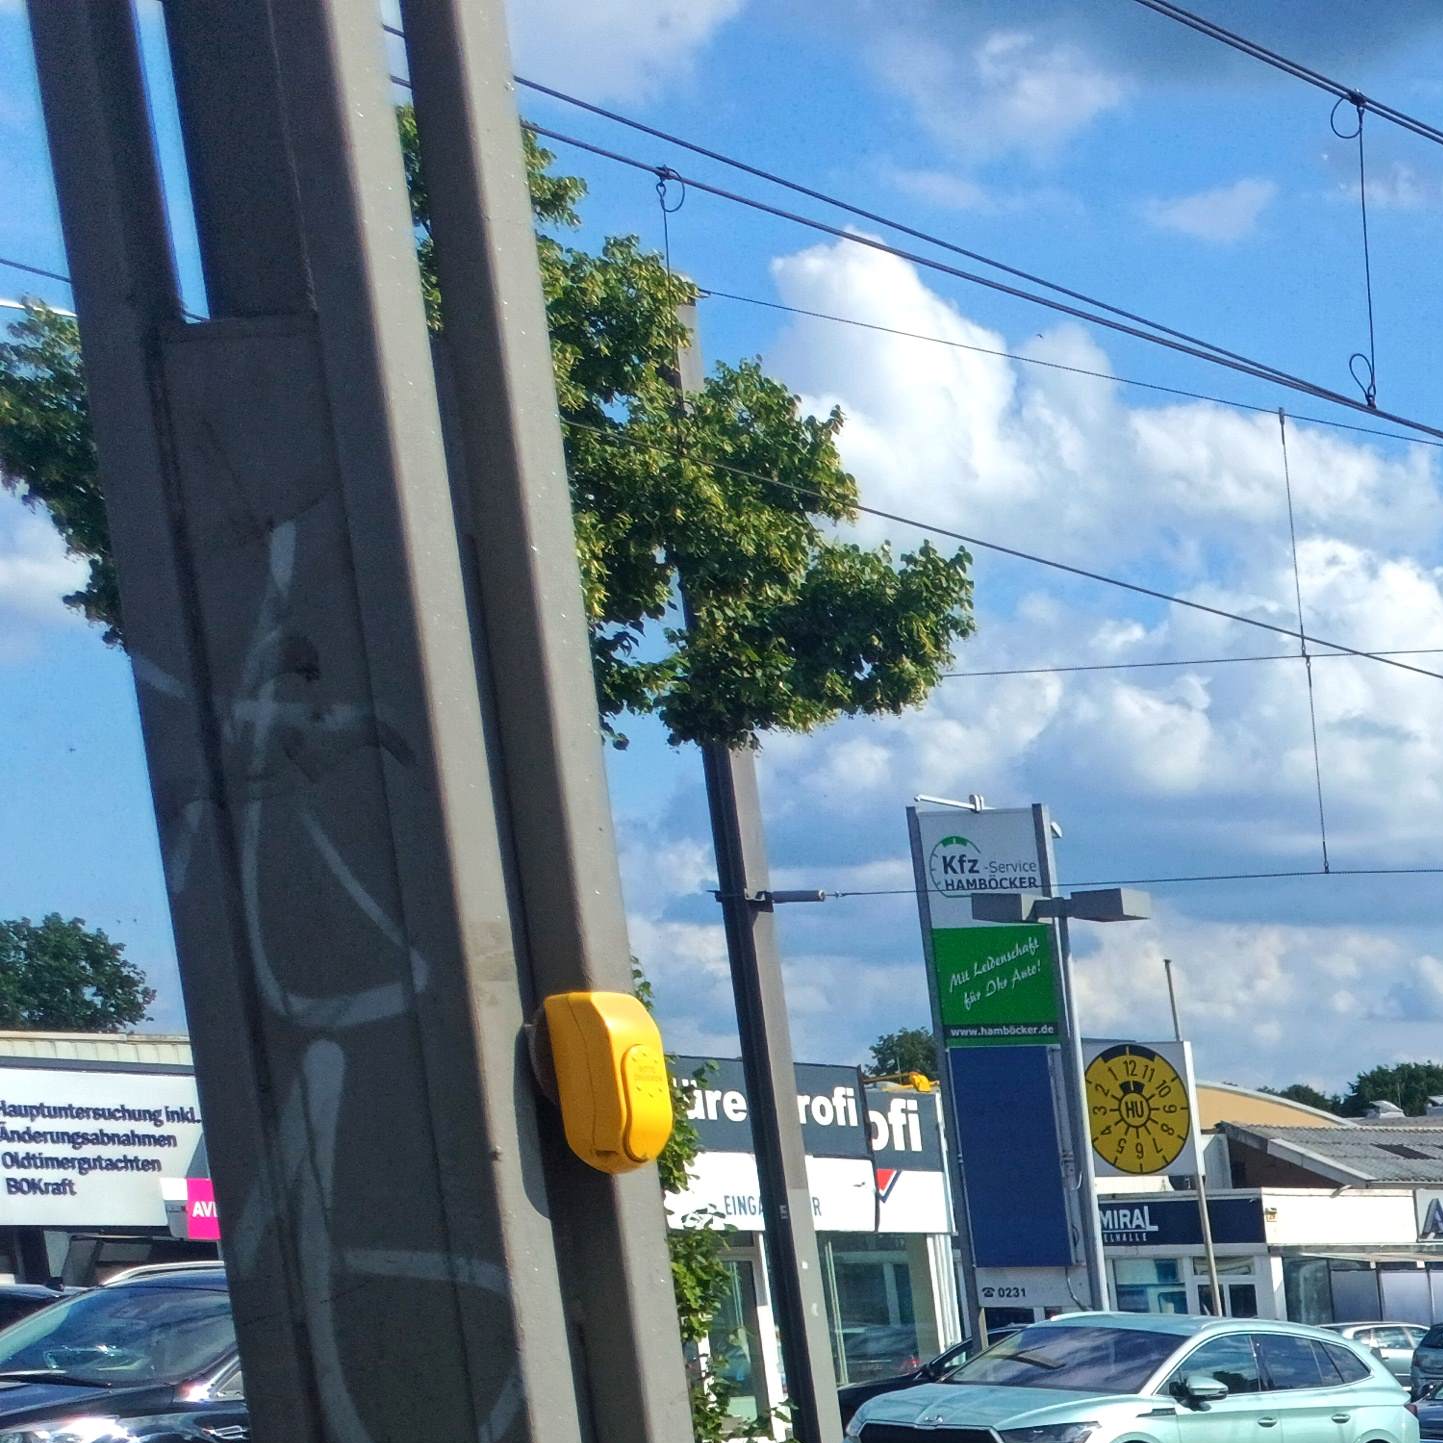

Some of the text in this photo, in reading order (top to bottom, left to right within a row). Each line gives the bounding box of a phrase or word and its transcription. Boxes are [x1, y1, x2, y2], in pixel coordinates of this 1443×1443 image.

[942, 854, 980, 875] Kfz
[945, 874, 1040, 892] HAMBÖCKER
[973, 936, 1040, 978] Leidenschaft
[950, 1024, 1054, 1037] www.hamböcker.de
[1108, 1066, 1118, 1080] 1
[1123, 1060, 1138, 1077] 12
[1142, 1064, 1155, 1082] 11
[1095, 1083, 1110, 1097] 2
[1156, 1080, 1171, 1098] 10
[797, 1087, 859, 1127] rofi
[1092, 1105, 1107, 1116] 3
[1125, 1100, 1144, 1118] HU
[1161, 1123, 1175, 1136] 8
[1, 1151, 163, 1176] Oldtimergutachten
[6, 1177, 77, 1196] BOKraft
[1099, 1205, 1158, 1232] MIRAL
[1103, 1232, 1148, 1243] ELHALLE
[998, 1287, 1026, 1299] 0231
